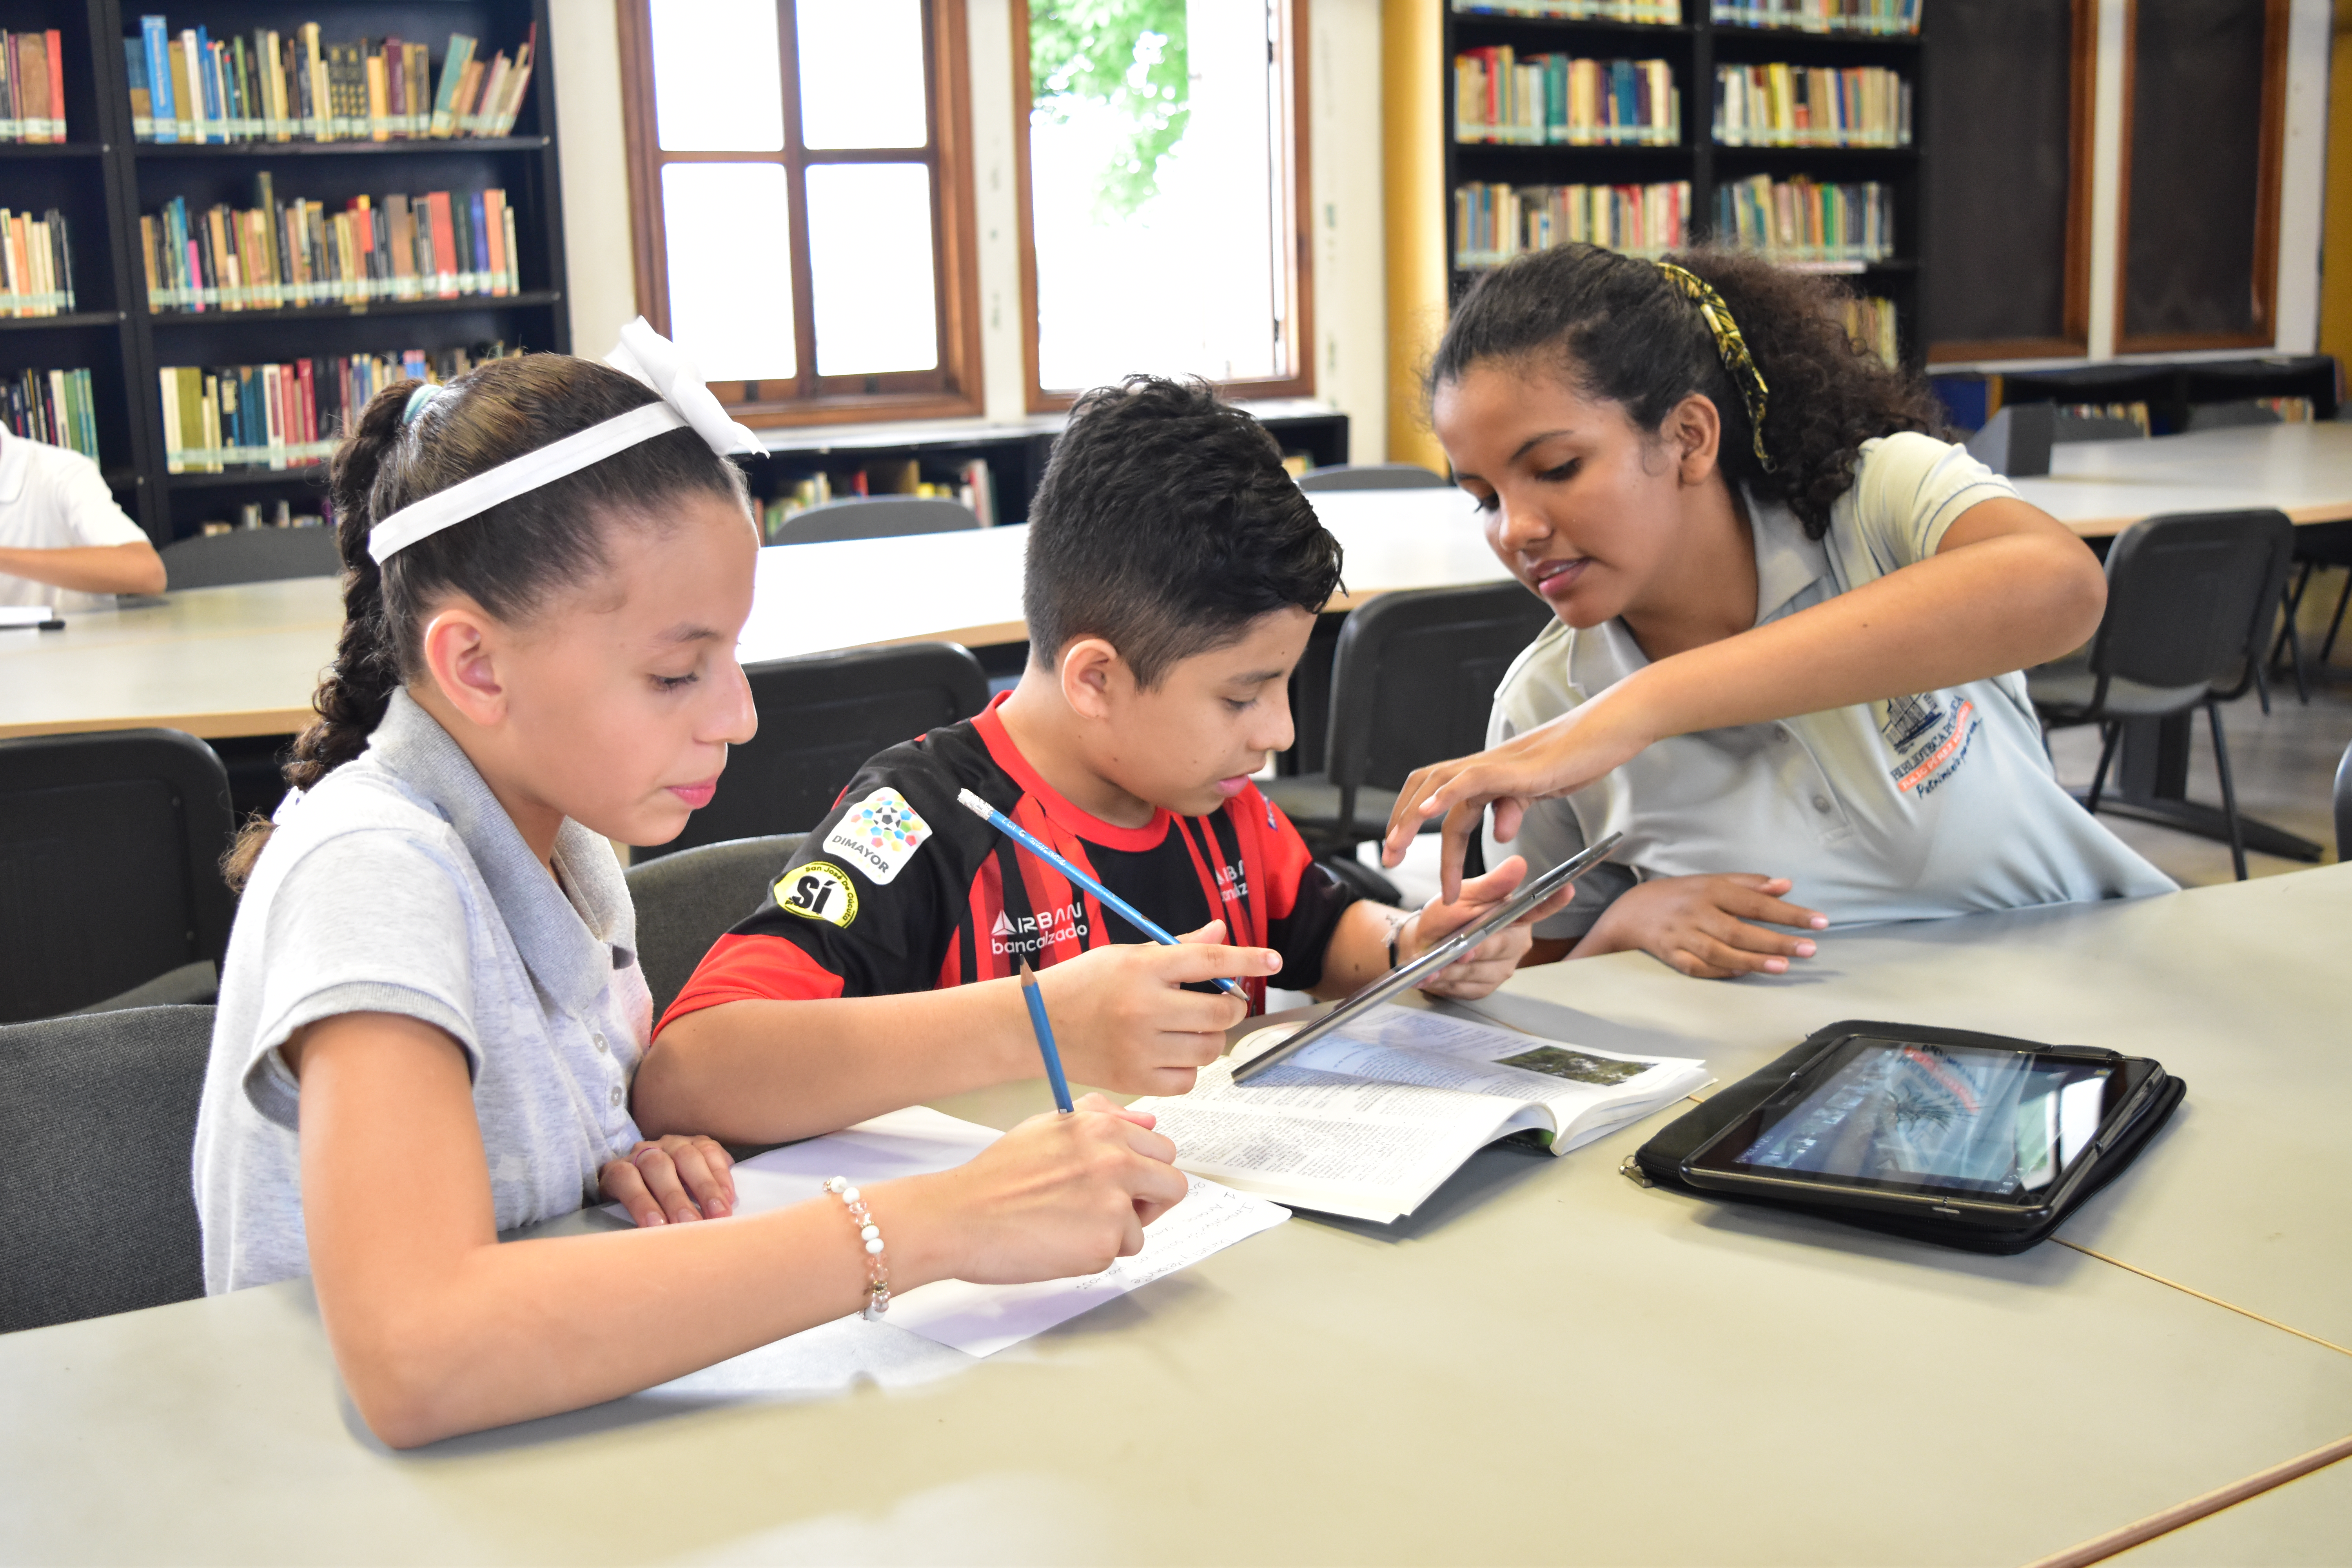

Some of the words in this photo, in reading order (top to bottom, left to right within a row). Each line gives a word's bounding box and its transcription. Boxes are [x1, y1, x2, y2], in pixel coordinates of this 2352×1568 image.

[832, 835, 889, 873] DIMAYOR
[824, 867, 842, 880] José
[841, 880, 850, 891] De
[842, 892, 855, 921] Cúcuta
[991, 922, 1088, 955] bancalzado
